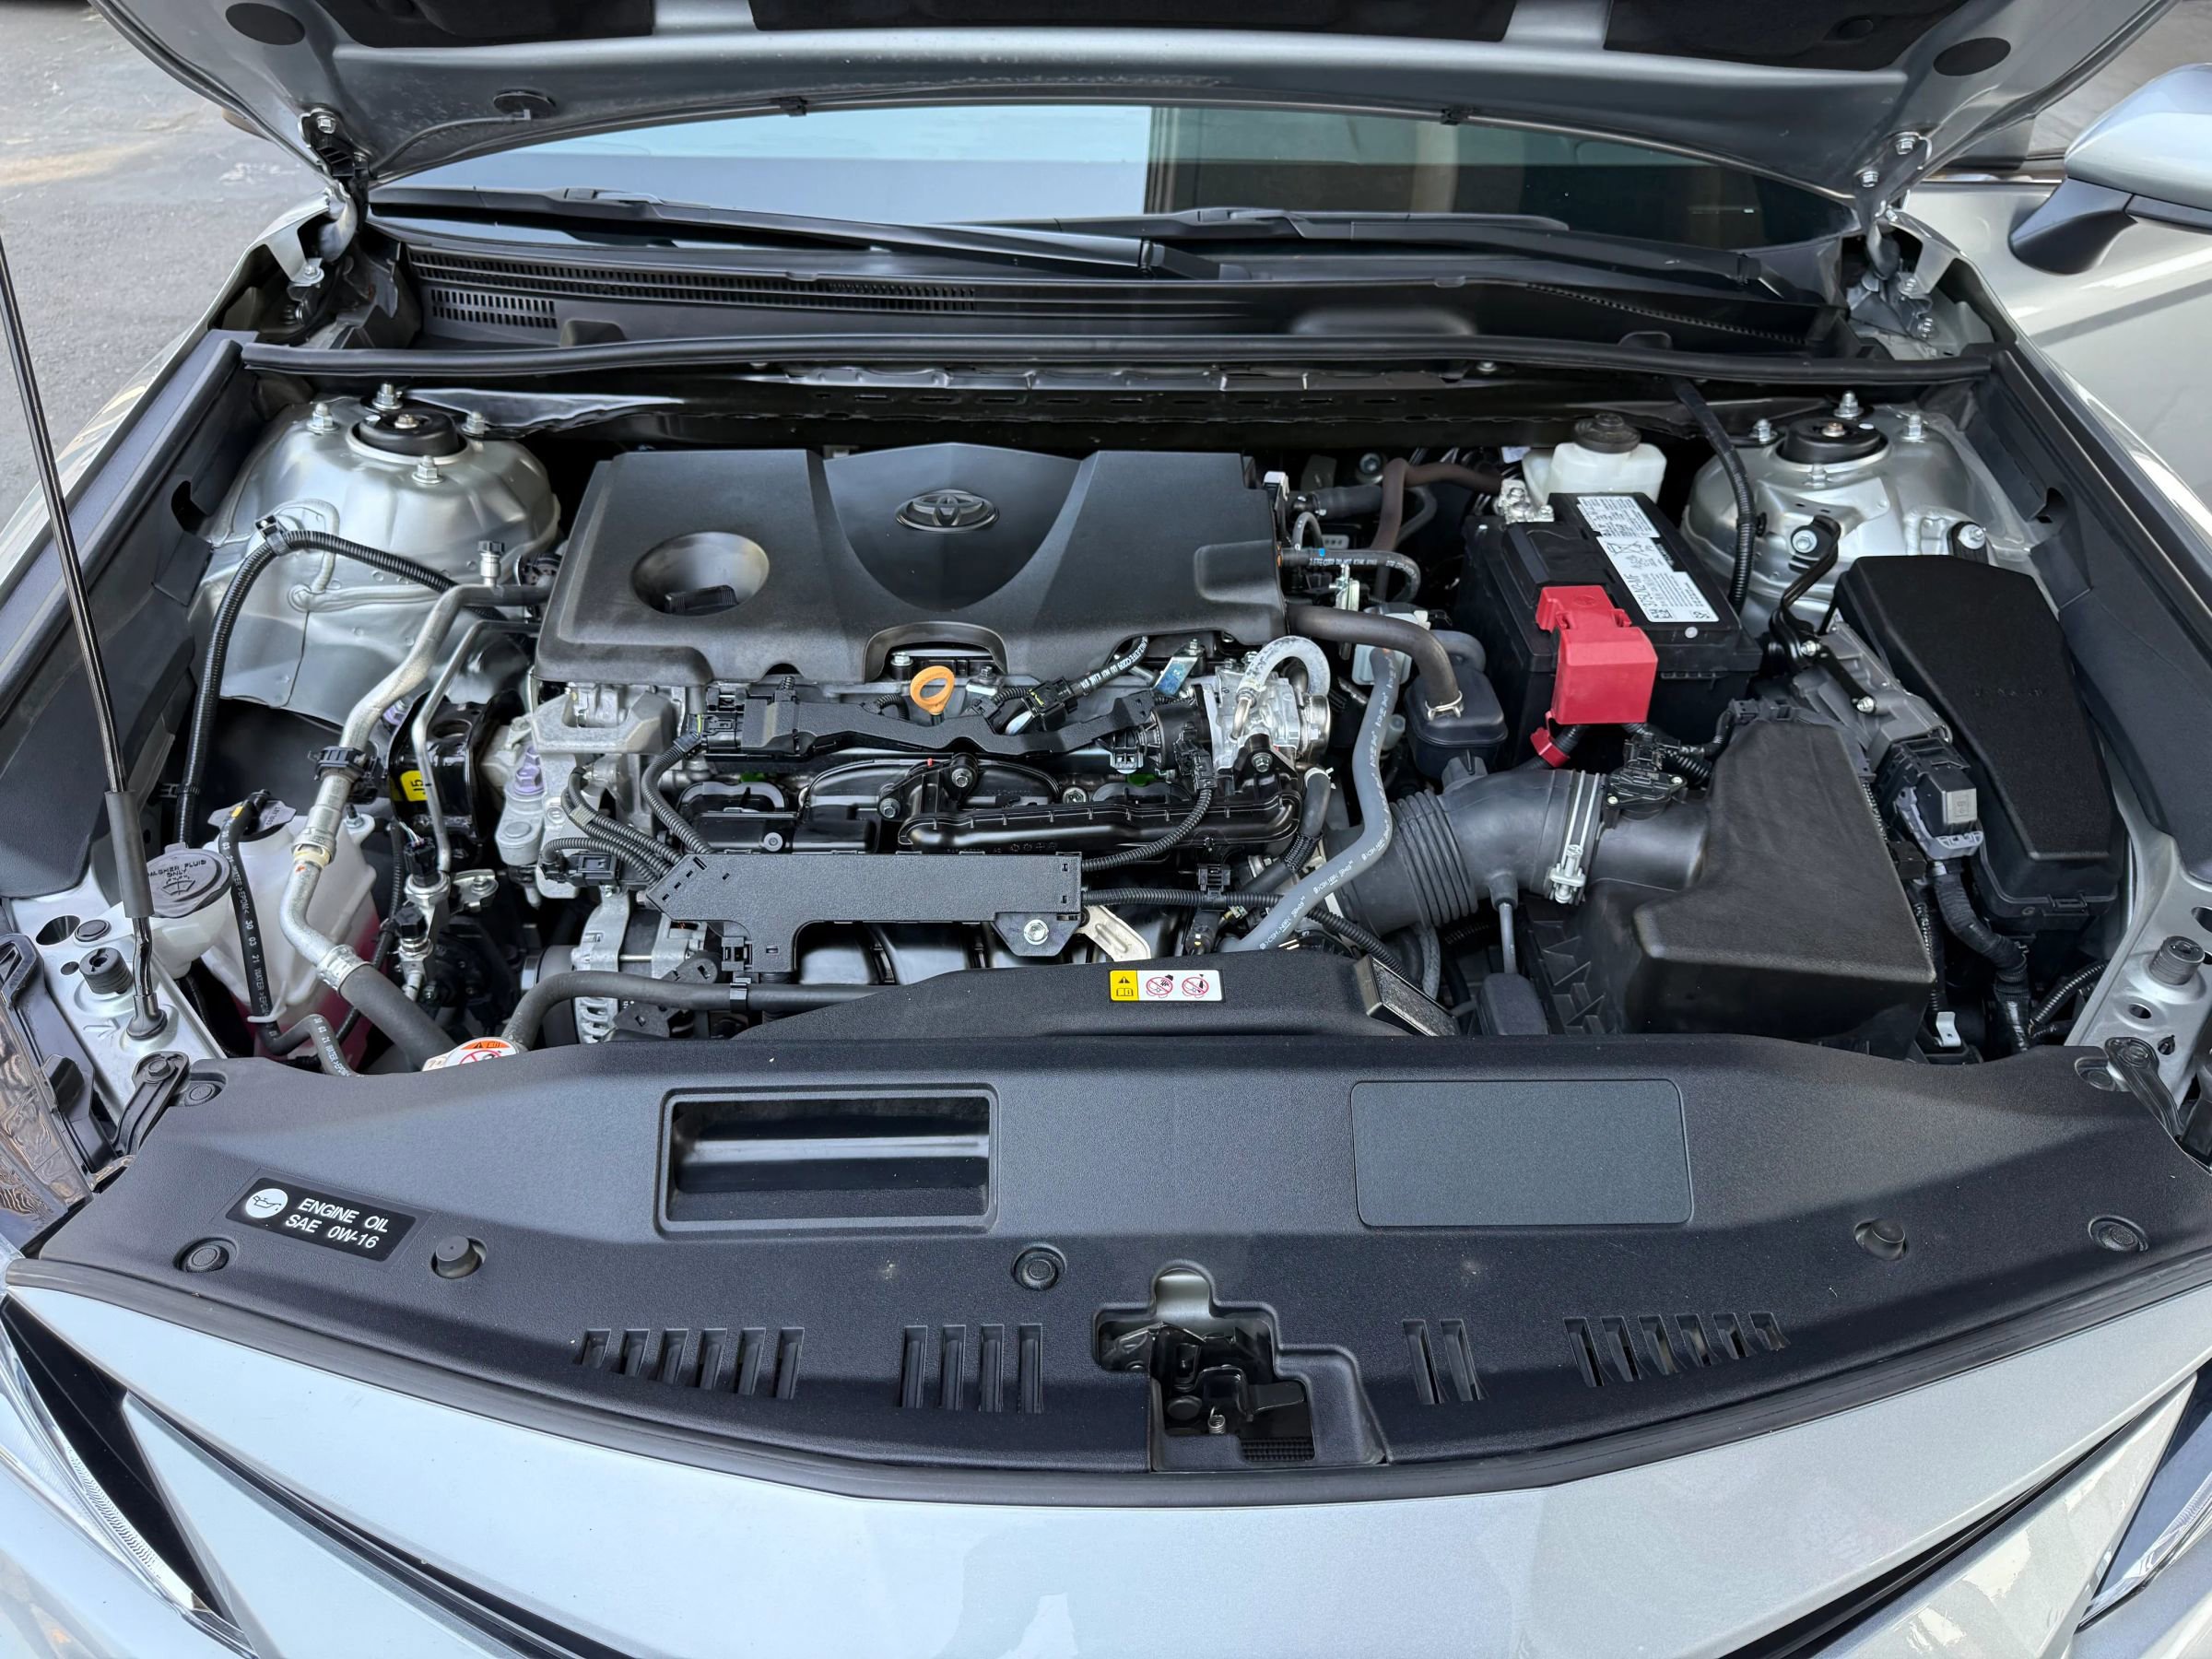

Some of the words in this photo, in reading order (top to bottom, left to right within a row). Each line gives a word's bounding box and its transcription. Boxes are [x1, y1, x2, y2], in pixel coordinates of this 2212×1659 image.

[147, 865, 180, 877] ASHER
[249, 936, 257, 947] 03
[252, 955, 260, 963] 21
[298, 1197, 359, 1224] ENGINE
[363, 1215, 389, 1233] OIL
[285, 1214, 323, 1234] SAE
[327, 1225, 380, 1249] 0W-16
